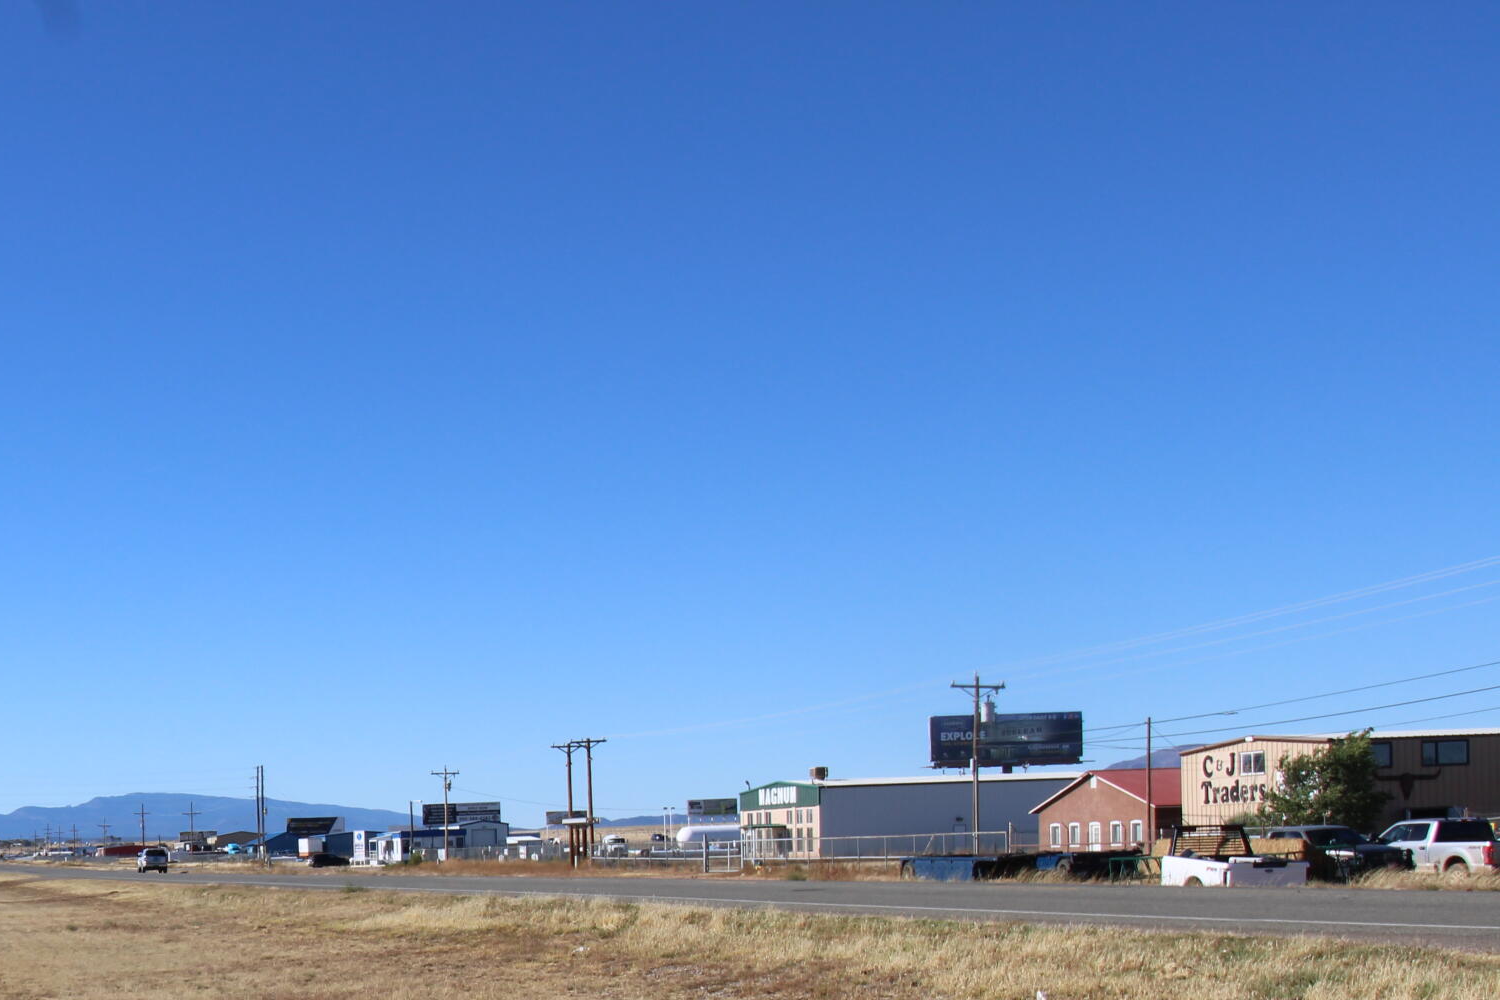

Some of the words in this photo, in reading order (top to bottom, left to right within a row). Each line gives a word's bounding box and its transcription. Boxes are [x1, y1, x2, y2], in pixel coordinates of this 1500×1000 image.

[940, 730, 986, 741] EXPLOE
[1202, 755, 1213, 778] C
[1226, 752, 1236, 776] J
[758, 786, 797, 806] MAGNUM
[1201, 779, 1267, 804] Traders
